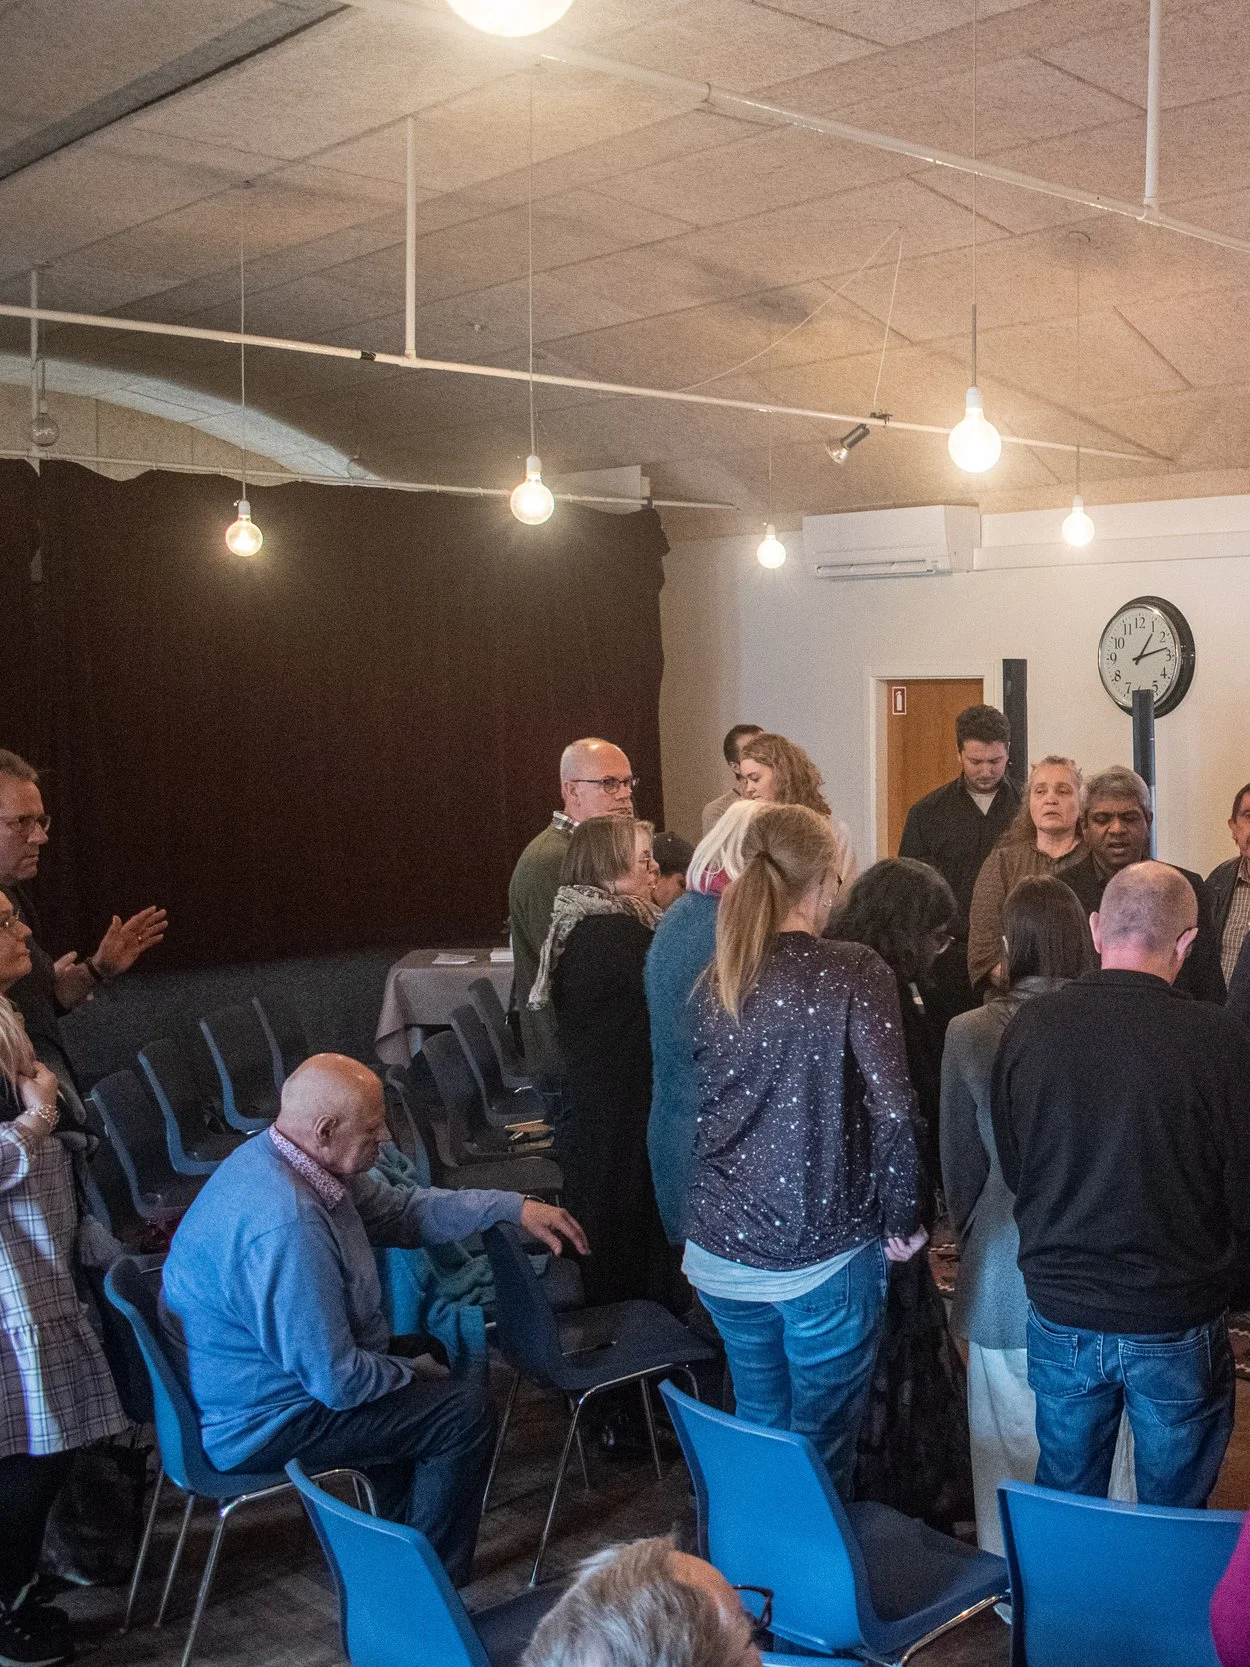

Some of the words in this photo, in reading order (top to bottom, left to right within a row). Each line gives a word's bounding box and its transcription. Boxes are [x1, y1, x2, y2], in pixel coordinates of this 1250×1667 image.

[1135, 616, 1146, 629] 12
[1123, 623, 1132, 636] 11
[1114, 637, 1125, 649] 10
[1159, 631, 1166, 643] 2
[1109, 652, 1117, 665] 9
[1165, 649, 1172, 662] 3
[1114, 669, 1121, 682] 8
[1160, 666, 1167, 679] 4
[1125, 681, 1132, 694] 7
[1152, 680, 1159, 693] 5
